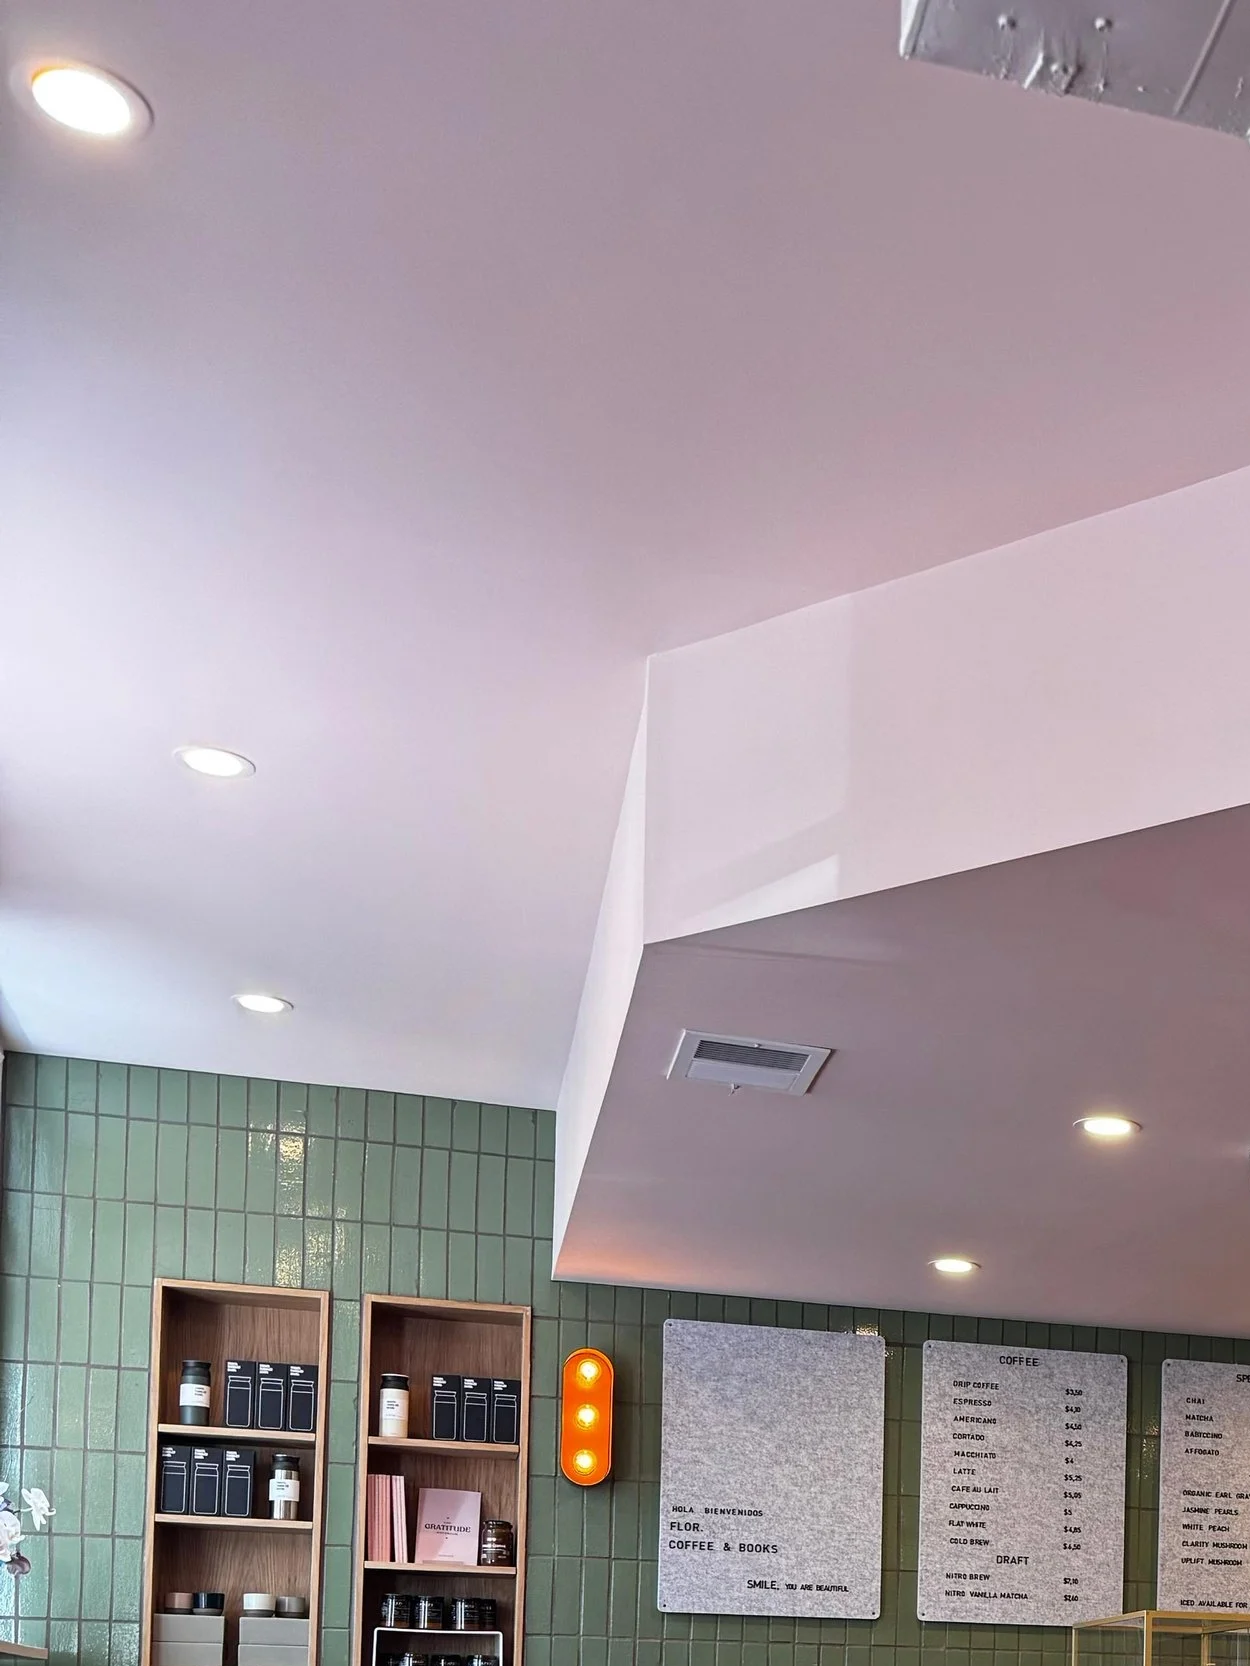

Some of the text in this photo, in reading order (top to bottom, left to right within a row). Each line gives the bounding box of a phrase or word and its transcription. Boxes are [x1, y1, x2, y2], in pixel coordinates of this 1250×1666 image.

[999, 1356, 1039, 1366] COFFEE
[973, 1382, 999, 1390] COFFEE
[953, 1398, 991, 1406] ESPRESSO
[954, 1416, 996, 1424] AMERICANO
[953, 1433, 984, 1441] CORTADO
[954, 1451, 996, 1459] MACCHIATO
[1185, 1448, 1219, 1456] AFFOGATO
[949, 1503, 989, 1511] CAPPUCCINO
[705, 1508, 763, 1516] BIENVENIDOS
[425, 1523, 471, 1532] GRATITUDE
[670, 1522, 703, 1532] FLOR.
[669, 1540, 778, 1553] COFFEE & BOOKS
[997, 1556, 1029, 1565] DRAFT
[1000, 1592, 1028, 1600] MATCHA
